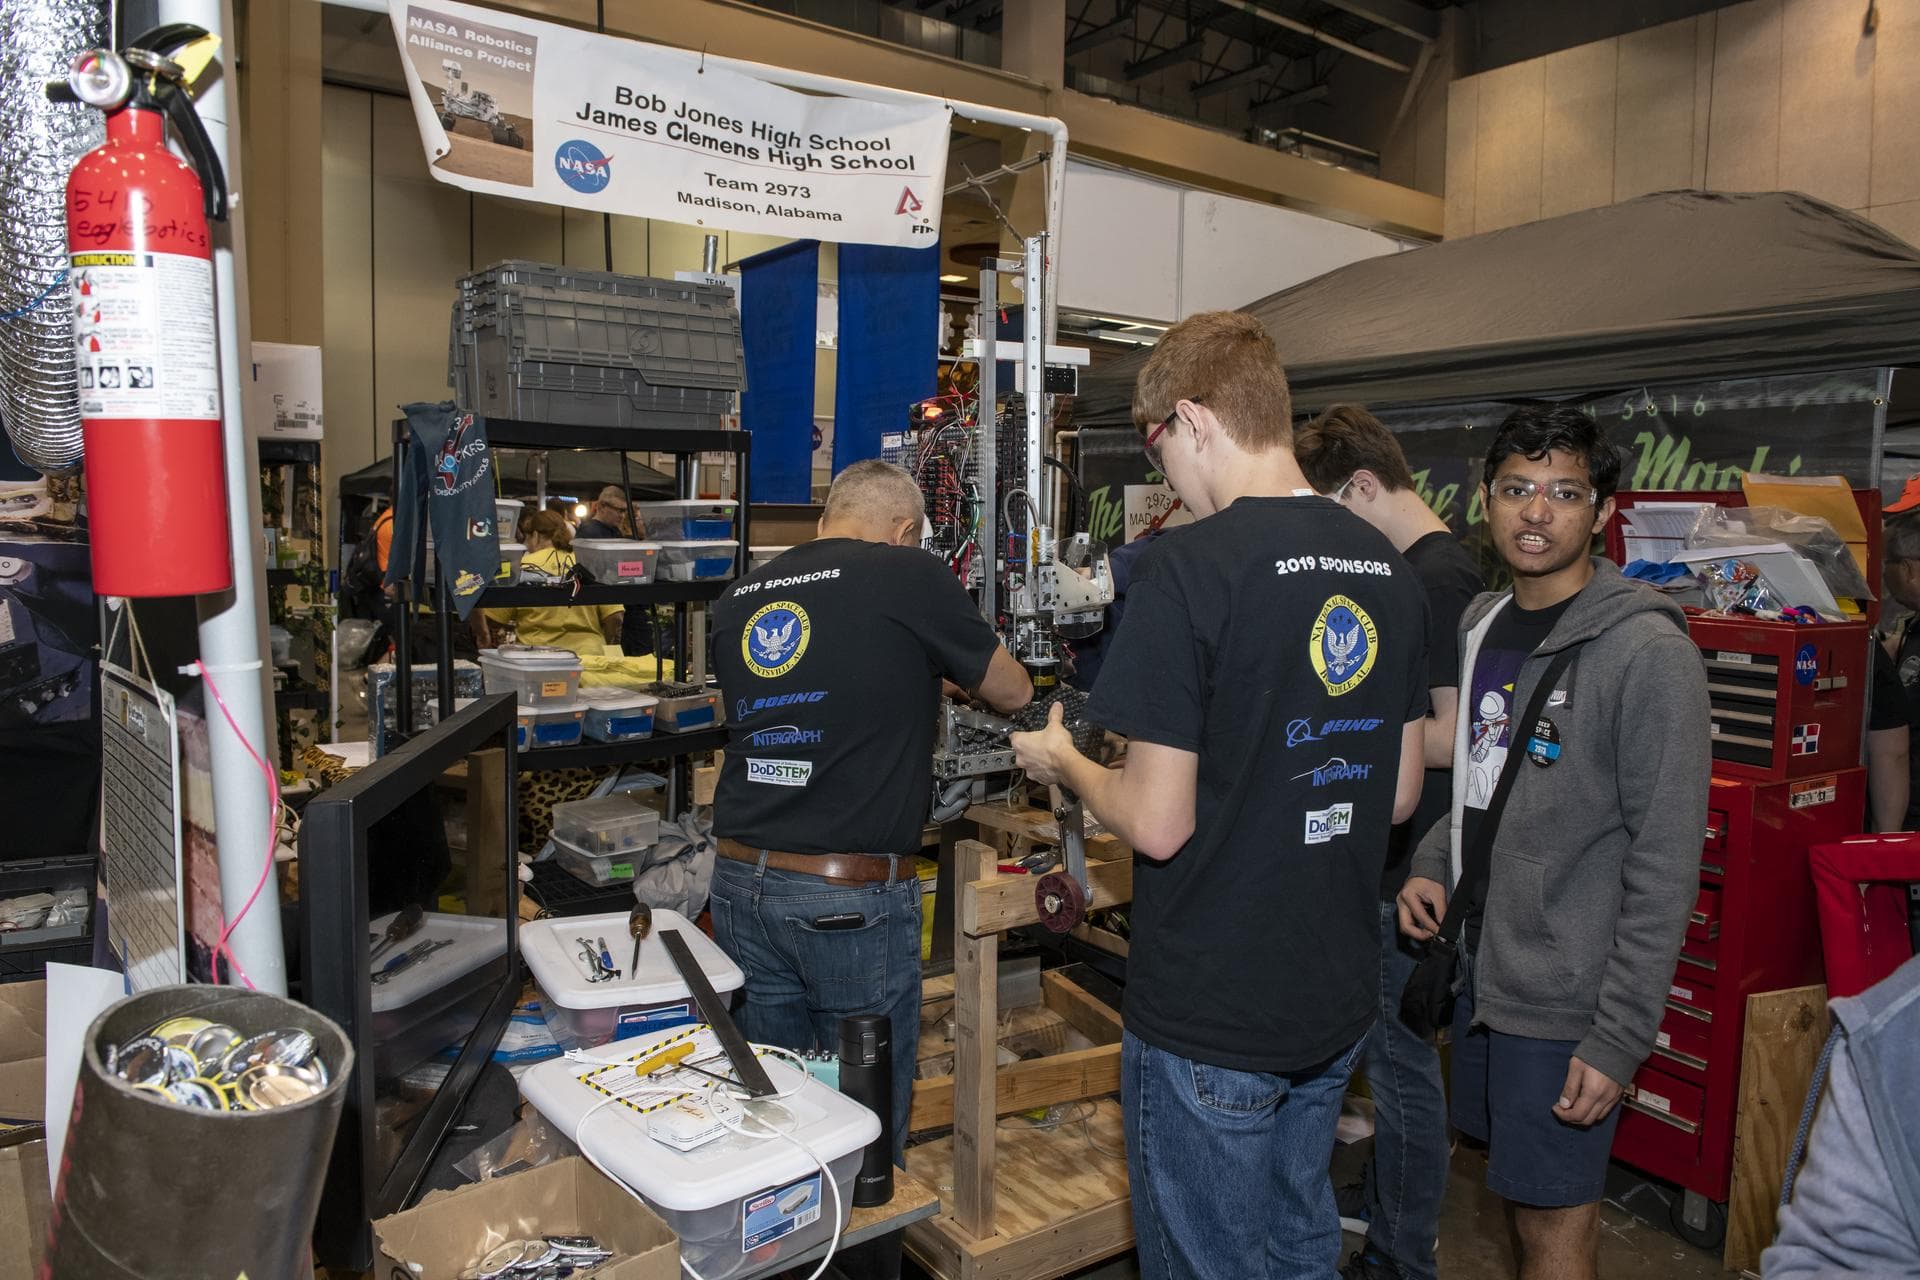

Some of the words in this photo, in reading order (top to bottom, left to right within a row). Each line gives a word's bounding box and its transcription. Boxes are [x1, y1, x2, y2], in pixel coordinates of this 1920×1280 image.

[410, 16, 458, 38] NASA
[464, 29, 533, 56] Robotics
[408, 34, 473, 58] Alliance
[477, 50, 532, 72] Project
[615, 86, 666, 113] Bob
[674, 102, 743, 133] Jones
[751, 120, 801, 148] High
[809, 134, 891, 151] School
[576, 102, 657, 135] James
[666, 121, 760, 160] Clemens
[768, 147, 822, 171] High
[831, 154, 915, 171] School
[559, 156, 608, 178] NASA
[704, 172, 758, 193] Team
[765, 182, 811, 199] 2973
[677, 191, 761, 215] Madison,
[765, 204, 843, 222] Alabama
[1145, 492, 1172, 511] 2973
[1275, 556, 1316, 575] 2019
[1319, 557, 1392, 576] SPONSORS
[733, 582, 761, 597] 2019
[764, 568, 841, 590] SPONSORS
[743, 604, 775, 640] NATIONAL
[776, 602, 798, 614] SPACE
[797, 611, 809, 631] CLUB
[1360, 615, 1377, 644] CLUB
[1796, 660, 1817, 670] NASA
[752, 691, 826, 710] BOEING
[753, 729, 822, 747] INTERGRAPH
